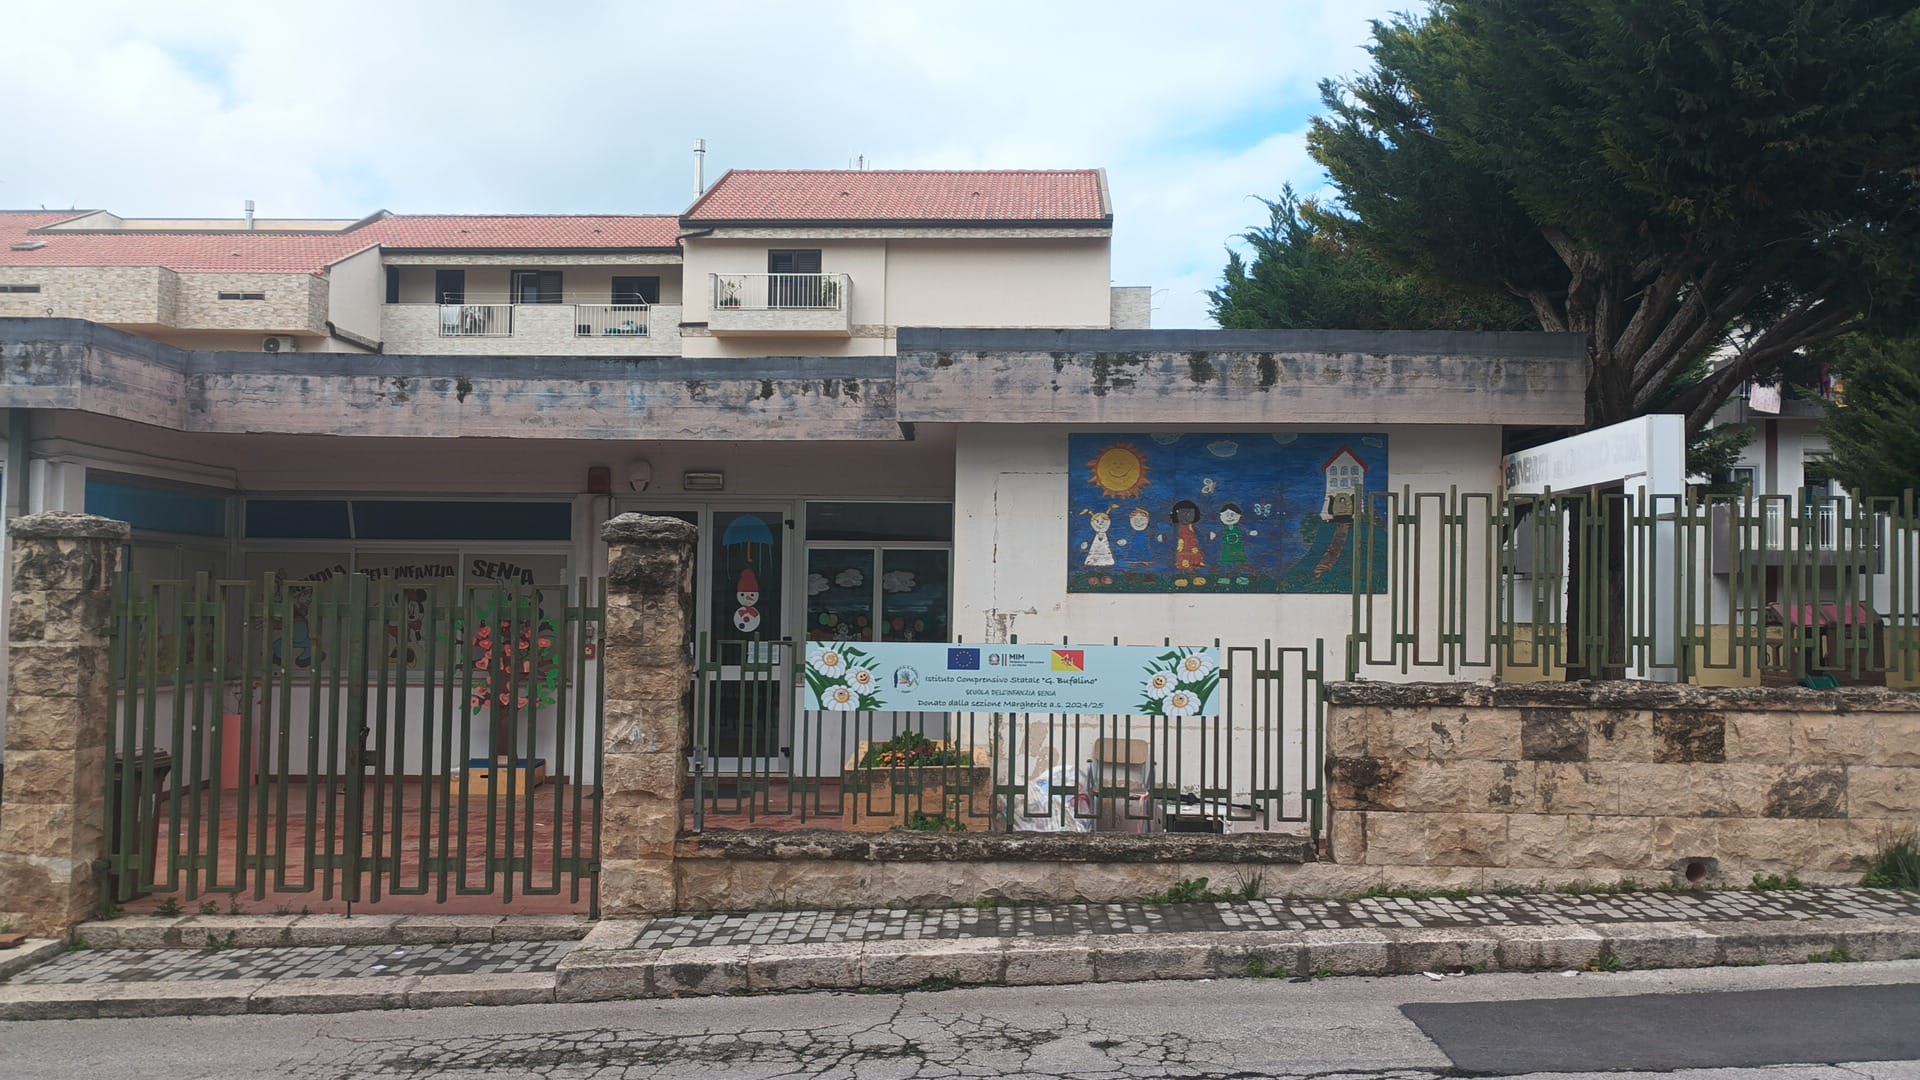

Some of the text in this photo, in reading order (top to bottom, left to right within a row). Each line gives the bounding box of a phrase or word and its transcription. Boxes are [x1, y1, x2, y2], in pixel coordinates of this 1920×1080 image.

[471, 559, 535, 585] SENIA
[925, 674, 955, 683] Istituto
[956, 675, 1008, 685] Comprensivo
[1009, 676, 1040, 684] Statale
[917, 699, 946, 707] Donato
[948, 699, 969, 707] dalla
[971, 699, 1001, 708] sezione
[1003, 700, 1048, 710] Margherite
[1065, 701, 1105, 709] 2024/25
